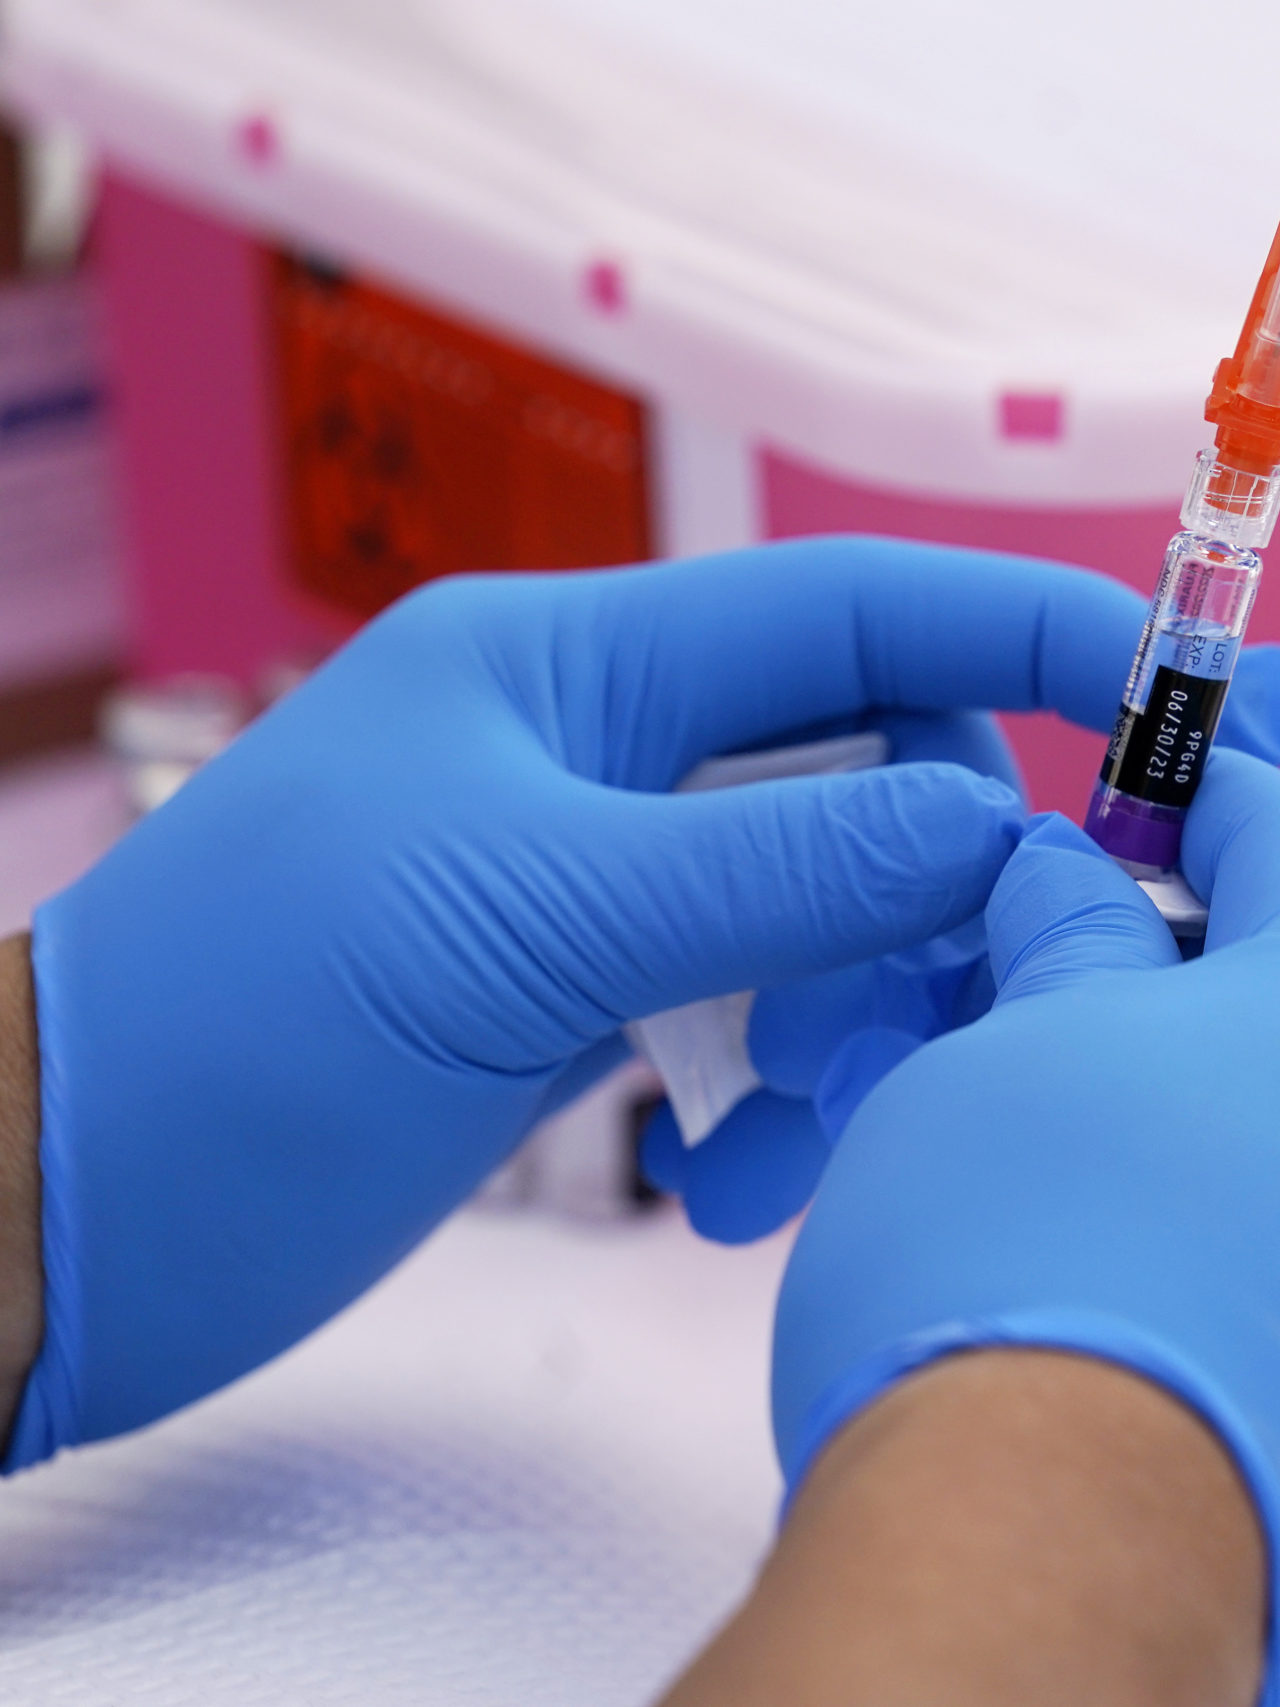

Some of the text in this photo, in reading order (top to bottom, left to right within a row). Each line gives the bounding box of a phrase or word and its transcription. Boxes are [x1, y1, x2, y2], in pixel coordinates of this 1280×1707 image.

[1159, 568, 1171, 598] NDC
[1147, 690, 1189, 780] 06/30/23
[1175, 642, 1228, 783] LOT: 9PG4D
